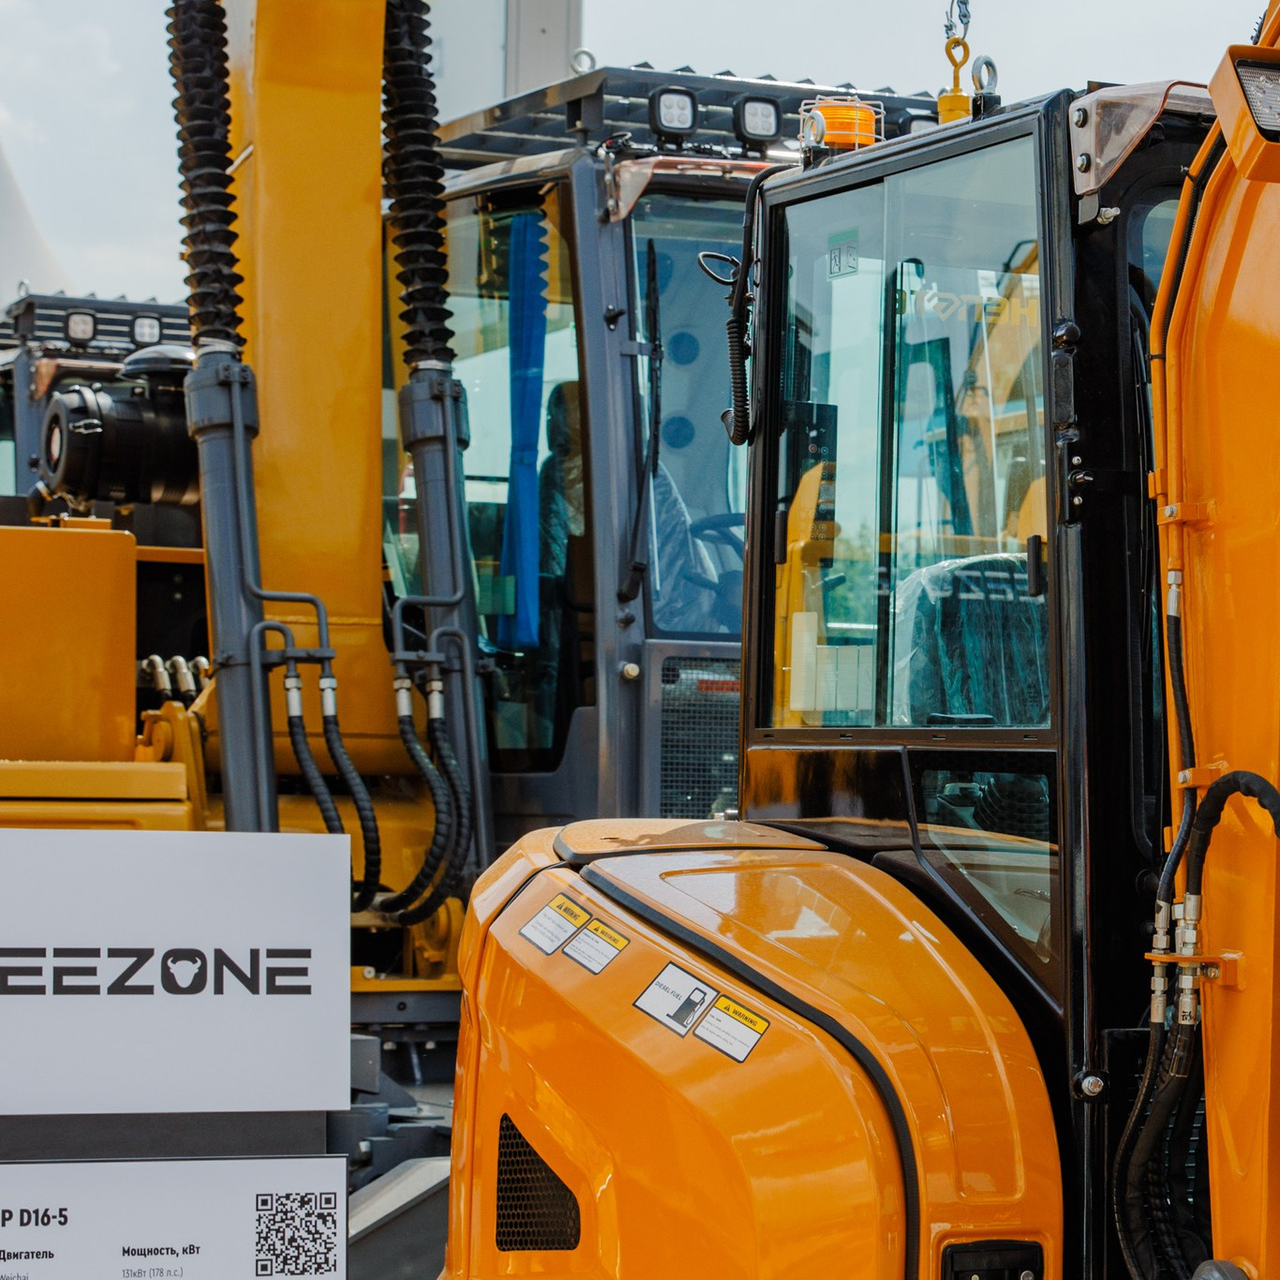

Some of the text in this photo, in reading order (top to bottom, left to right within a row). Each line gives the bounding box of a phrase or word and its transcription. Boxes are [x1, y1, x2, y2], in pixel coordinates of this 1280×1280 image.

[654, 981, 683, 1001] DIESEL FUEL
[732, 1008, 758, 1027] WARNING
[19, 1208, 68, 1227] D16-5
[0, 1250, 54, 1262] Двигатель
[122, 1244, 201, 1258] Мощность, кВт
[149, 1268, 165, 1279] (178
